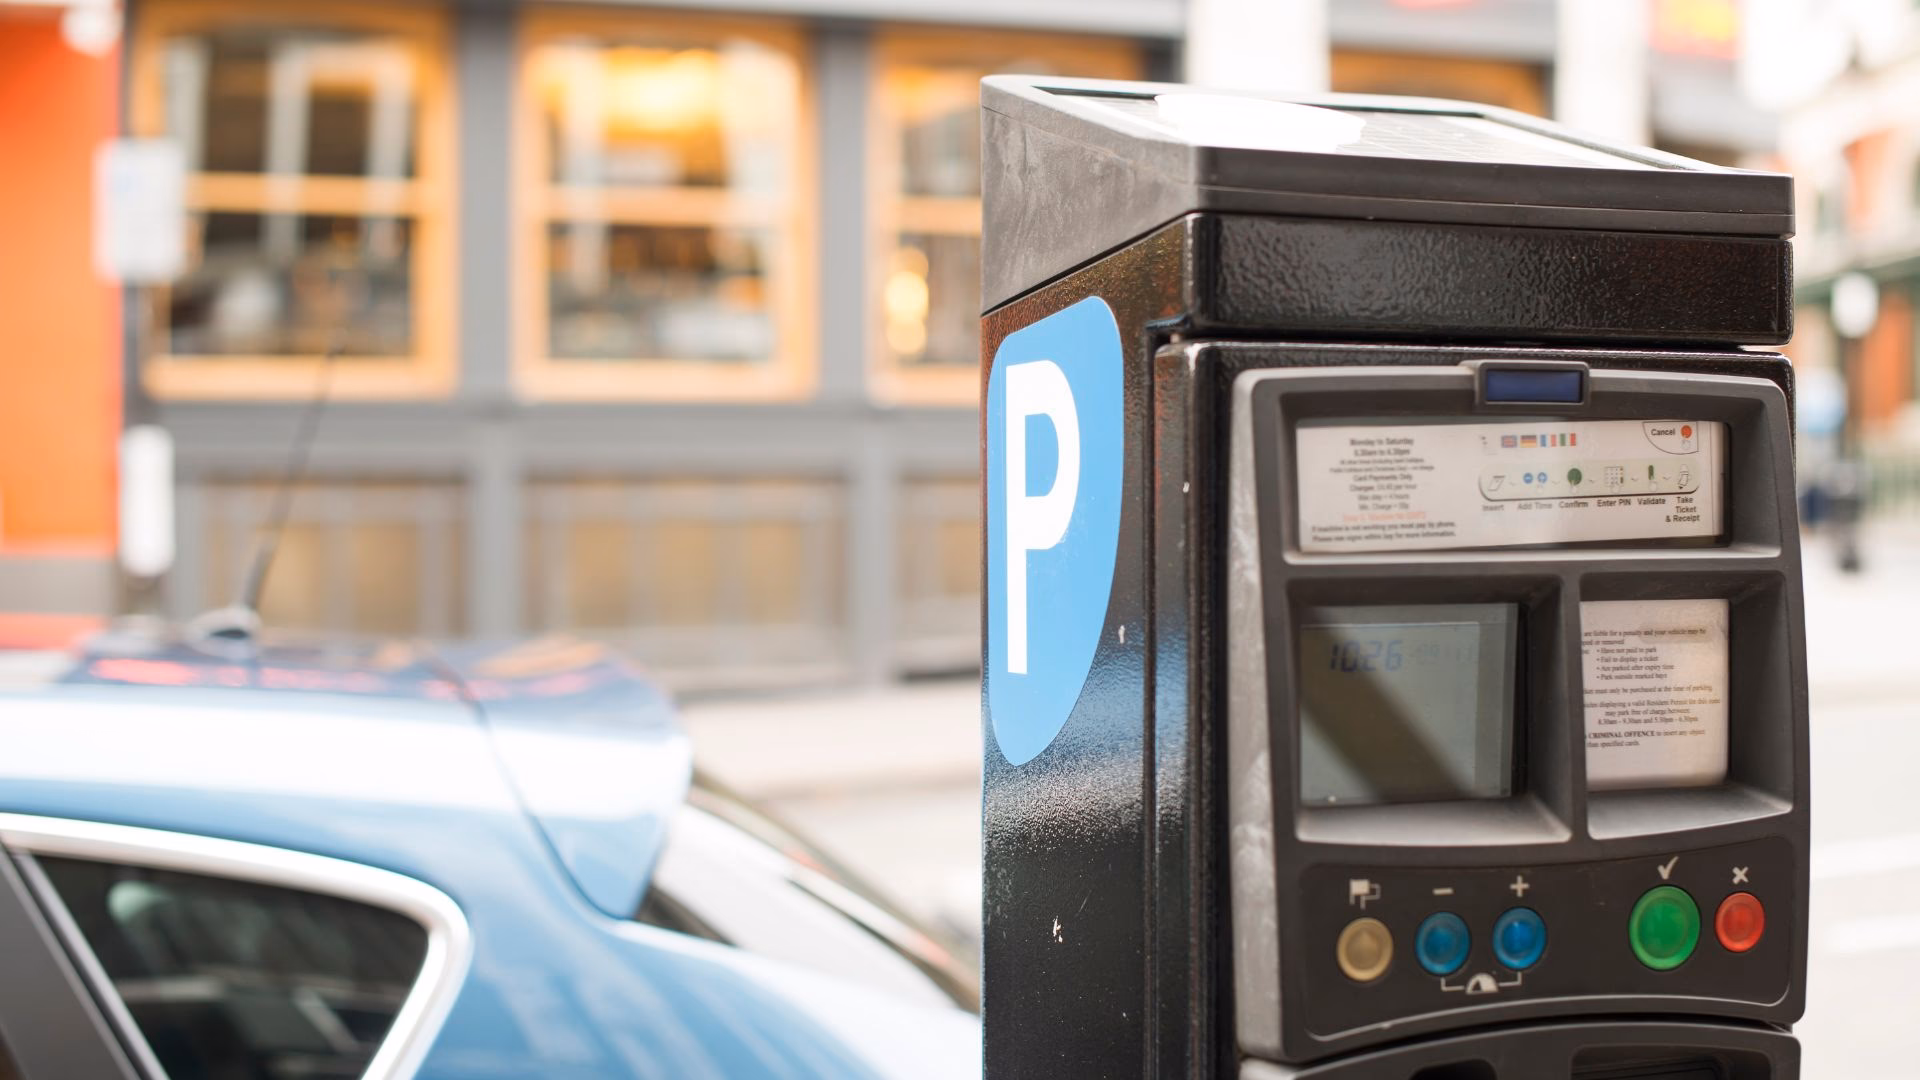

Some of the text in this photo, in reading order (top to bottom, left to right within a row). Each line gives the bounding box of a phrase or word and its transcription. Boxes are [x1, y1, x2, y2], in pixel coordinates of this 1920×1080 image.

[1651, 428, 1676, 436] Cancel
[1350, 438, 1374, 446] Monday
[1386, 437, 1414, 446] Saturday
[1399, 473, 1413, 481] Only
[1597, 499, 1616, 507] Enter
[1637, 497, 1666, 505] Validate
[1372, 502, 1391, 511] Charge
[1518, 501, 1553, 510] Add Time
[1006, 359, 1080, 675] P
[1673, 514, 1700, 522] Receipt
[1619, 656, 1638, 664] display
[1600, 673, 1613, 681] Park
[1600, 700, 1626, 708] displaying
[1588, 731, 1623, 739] CRIMINAL
